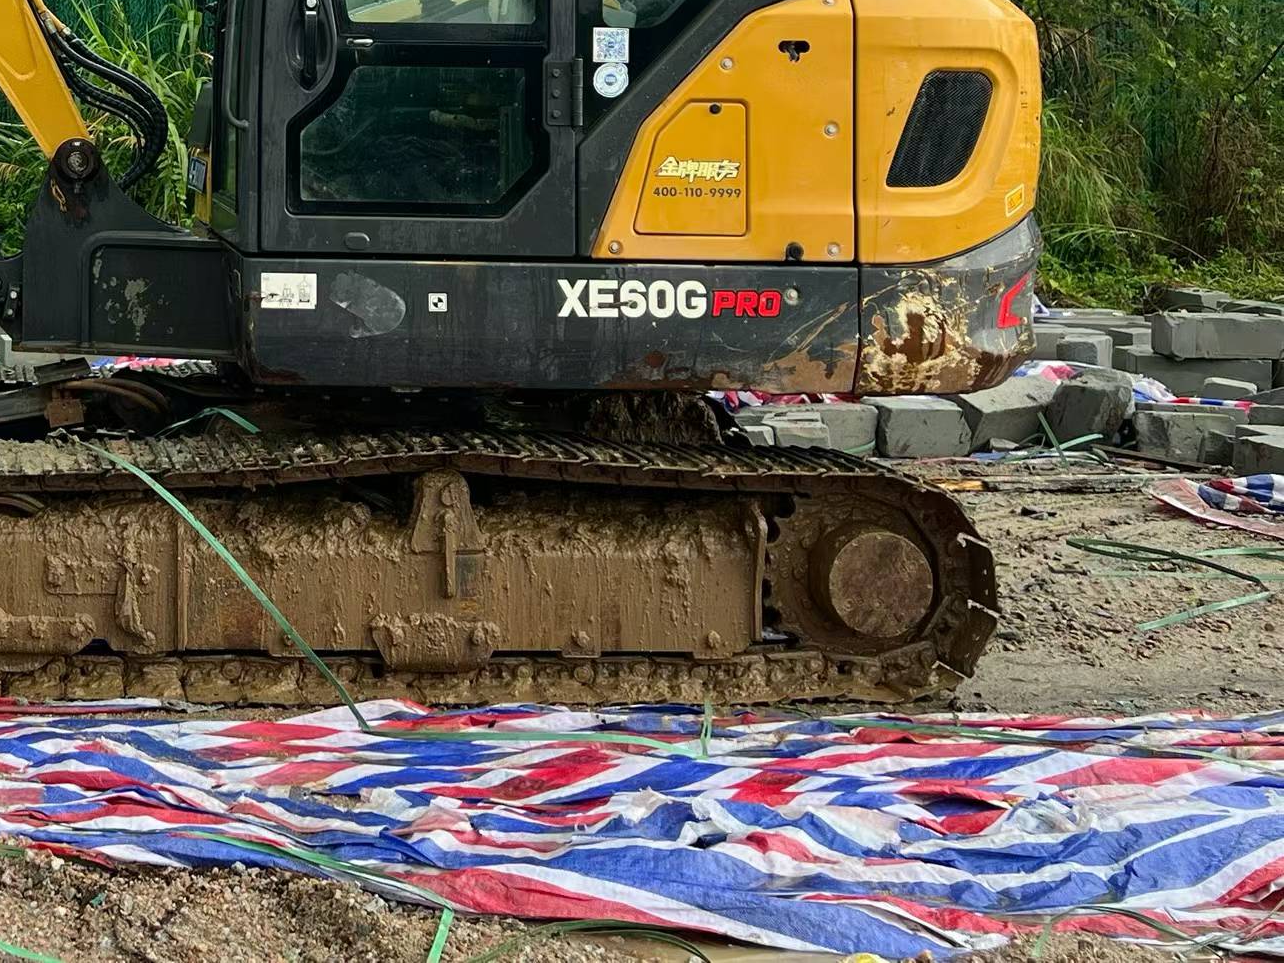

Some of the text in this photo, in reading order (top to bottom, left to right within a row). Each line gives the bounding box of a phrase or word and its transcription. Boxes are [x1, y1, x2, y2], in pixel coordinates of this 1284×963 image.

[653, 187, 742, 198] 400-110-9999
[557, 279, 782, 318] XE60G PRO
